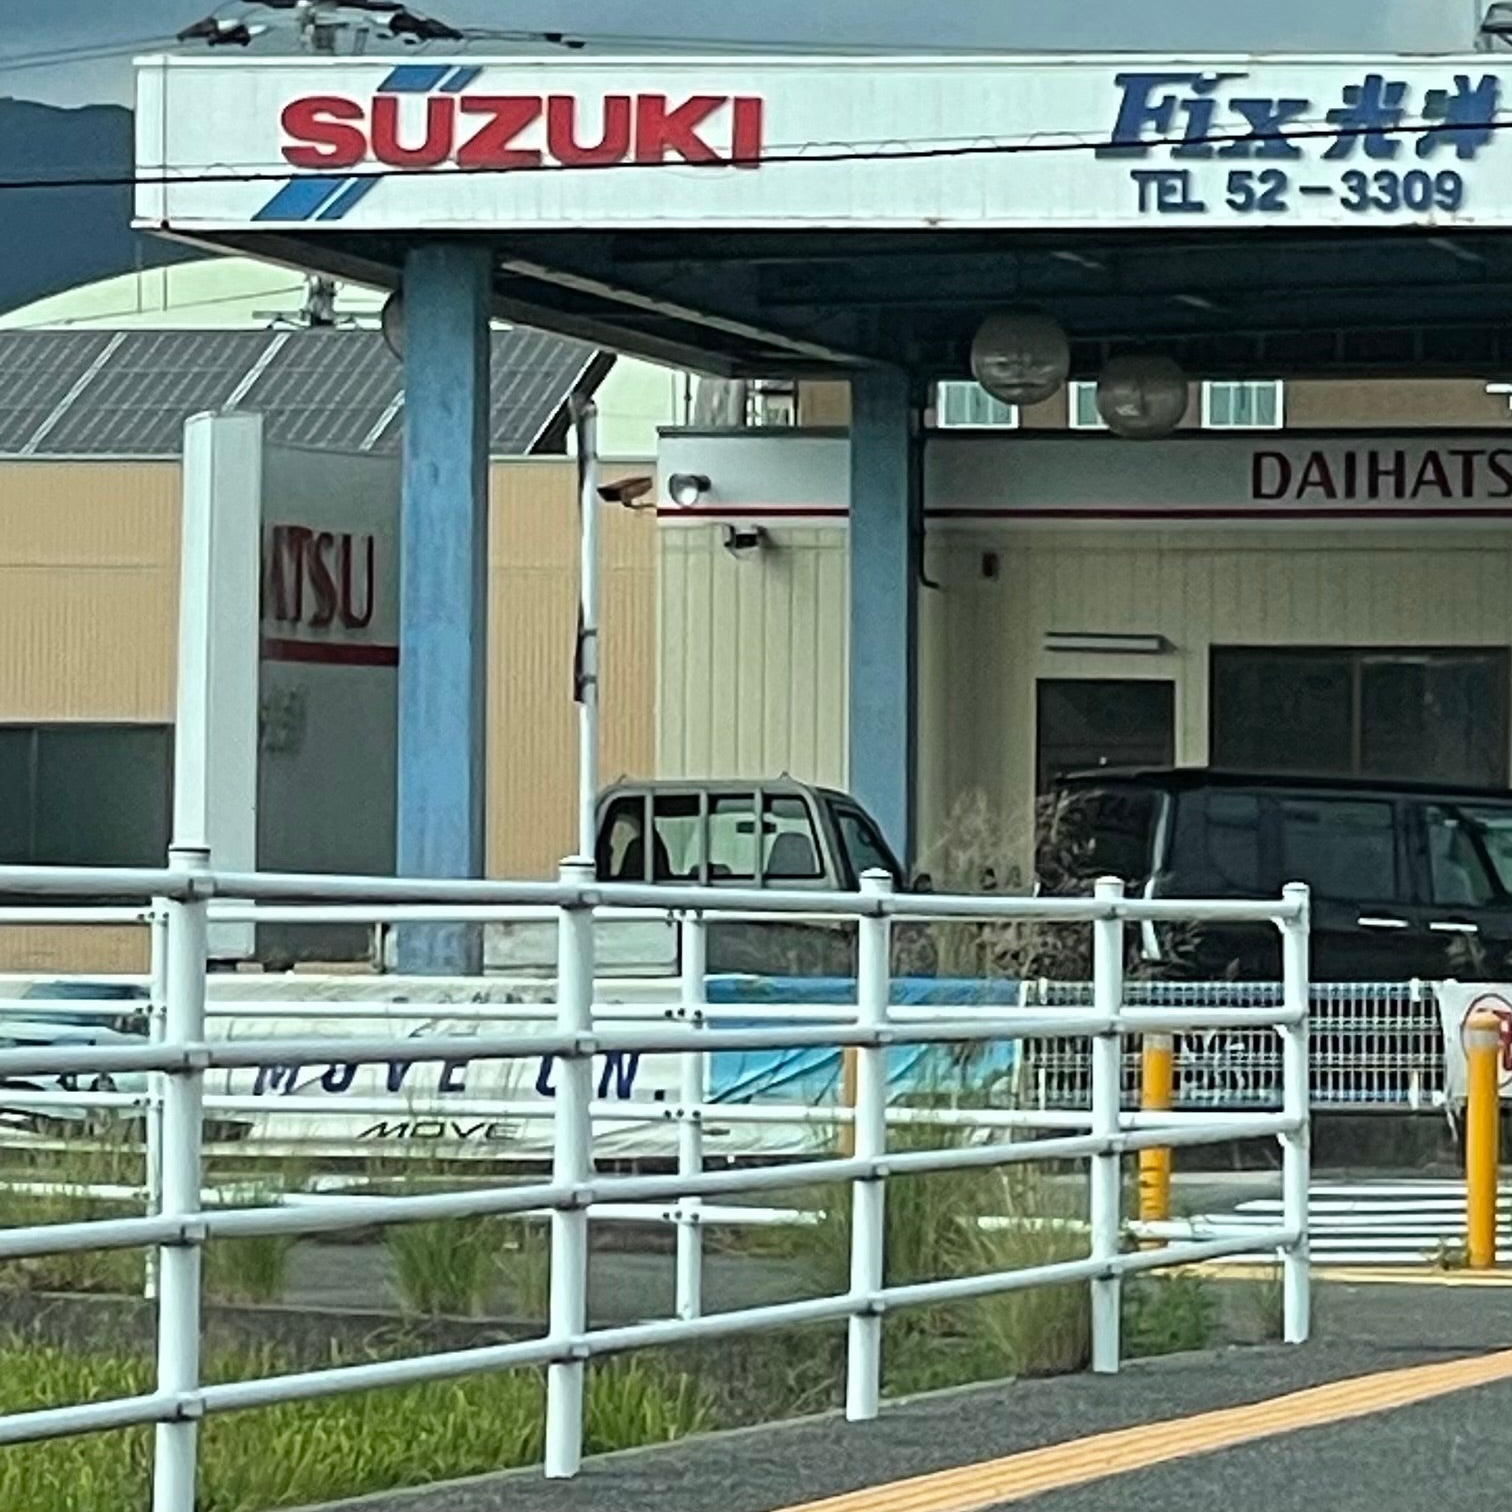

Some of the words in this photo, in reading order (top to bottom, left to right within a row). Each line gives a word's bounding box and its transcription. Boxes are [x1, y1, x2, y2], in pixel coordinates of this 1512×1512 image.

[280, 95, 762, 169] SUZUKI
[1095, 72, 1309, 159] Fix
[1131, 170, 1206, 212] TEL
[1226, 168, 1463, 212] 52-3309
[356, 1121, 522, 1140] MOVE
